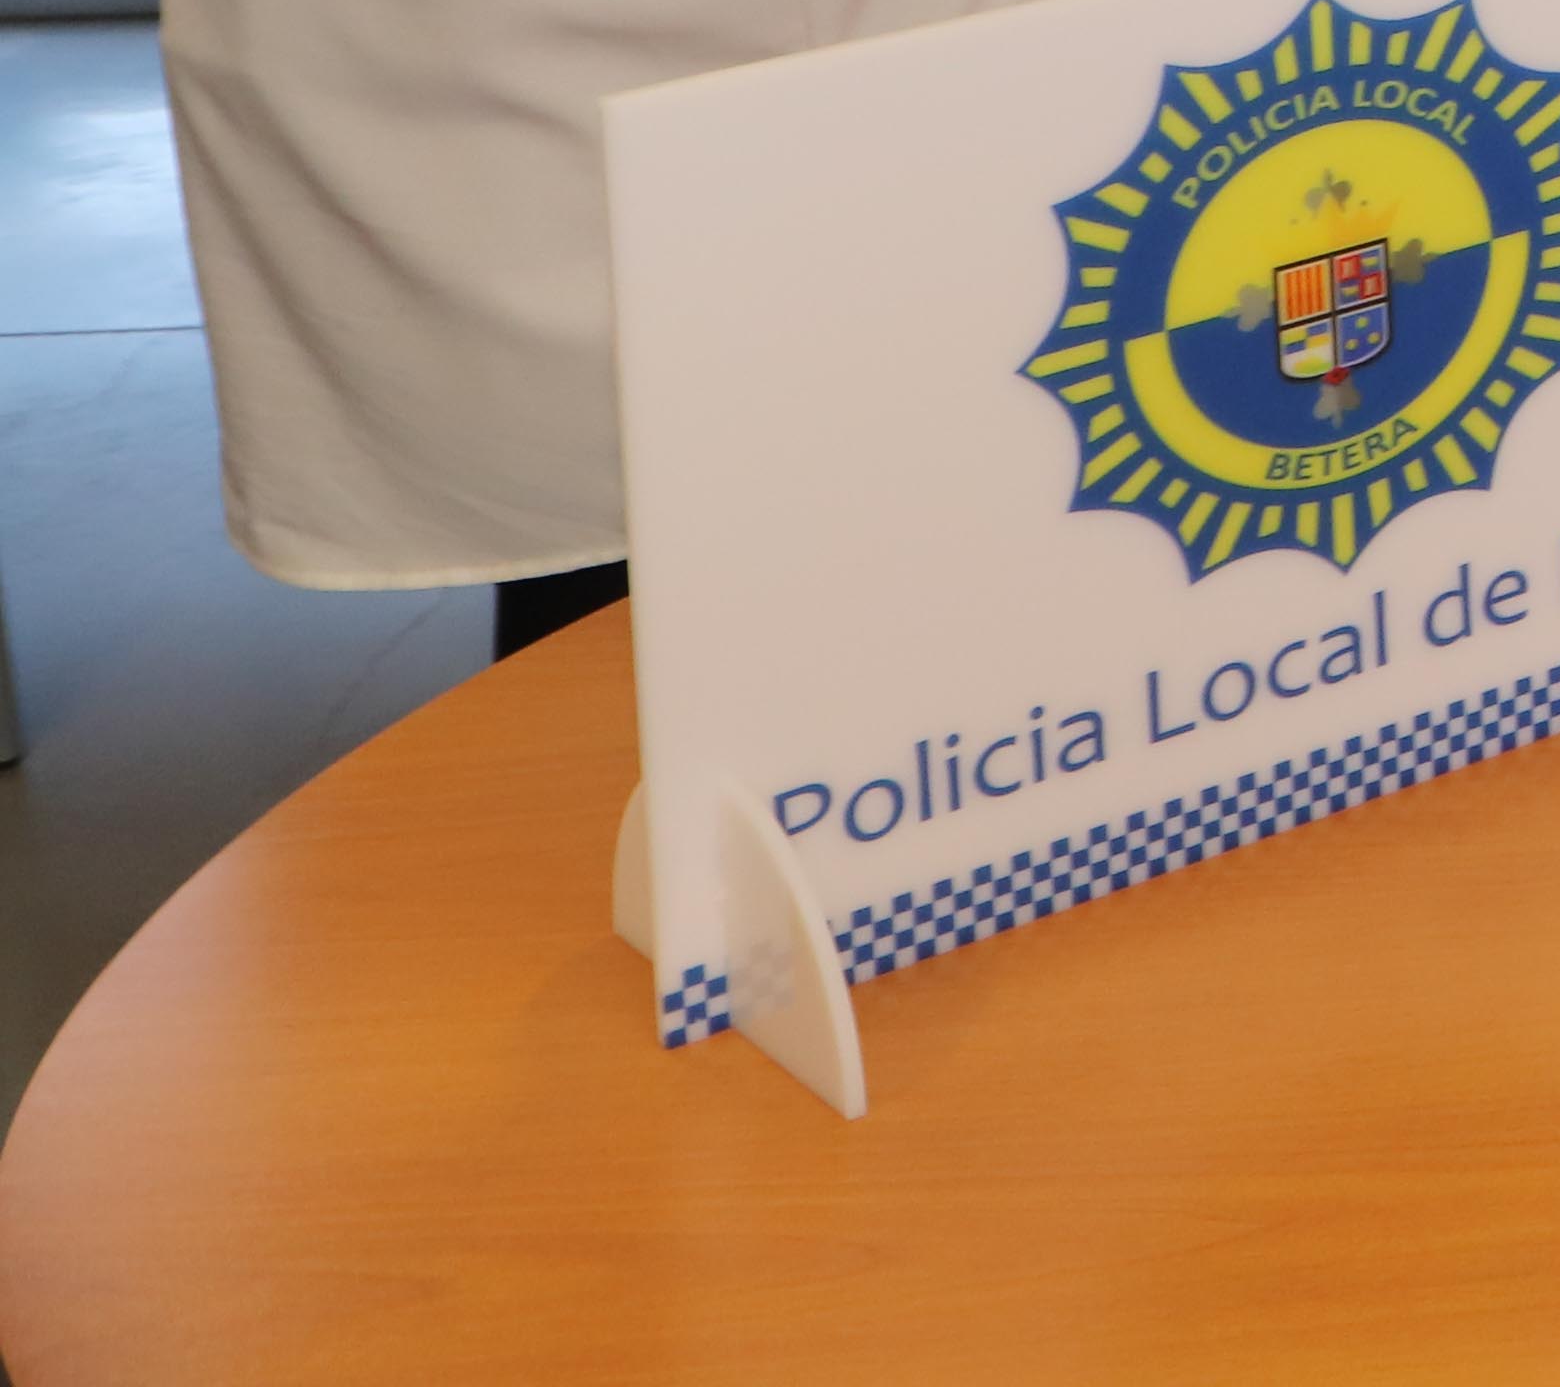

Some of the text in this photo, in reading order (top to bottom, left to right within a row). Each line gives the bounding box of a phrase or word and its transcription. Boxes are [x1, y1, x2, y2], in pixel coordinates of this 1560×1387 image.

[1172, 79, 1477, 209] POLICIA LOCAL
[1265, 417, 1419, 482] BETERA
[773, 705, 1105, 843] Policia
[1146, 589, 1389, 745] Local
[1423, 563, 1530, 647] de
